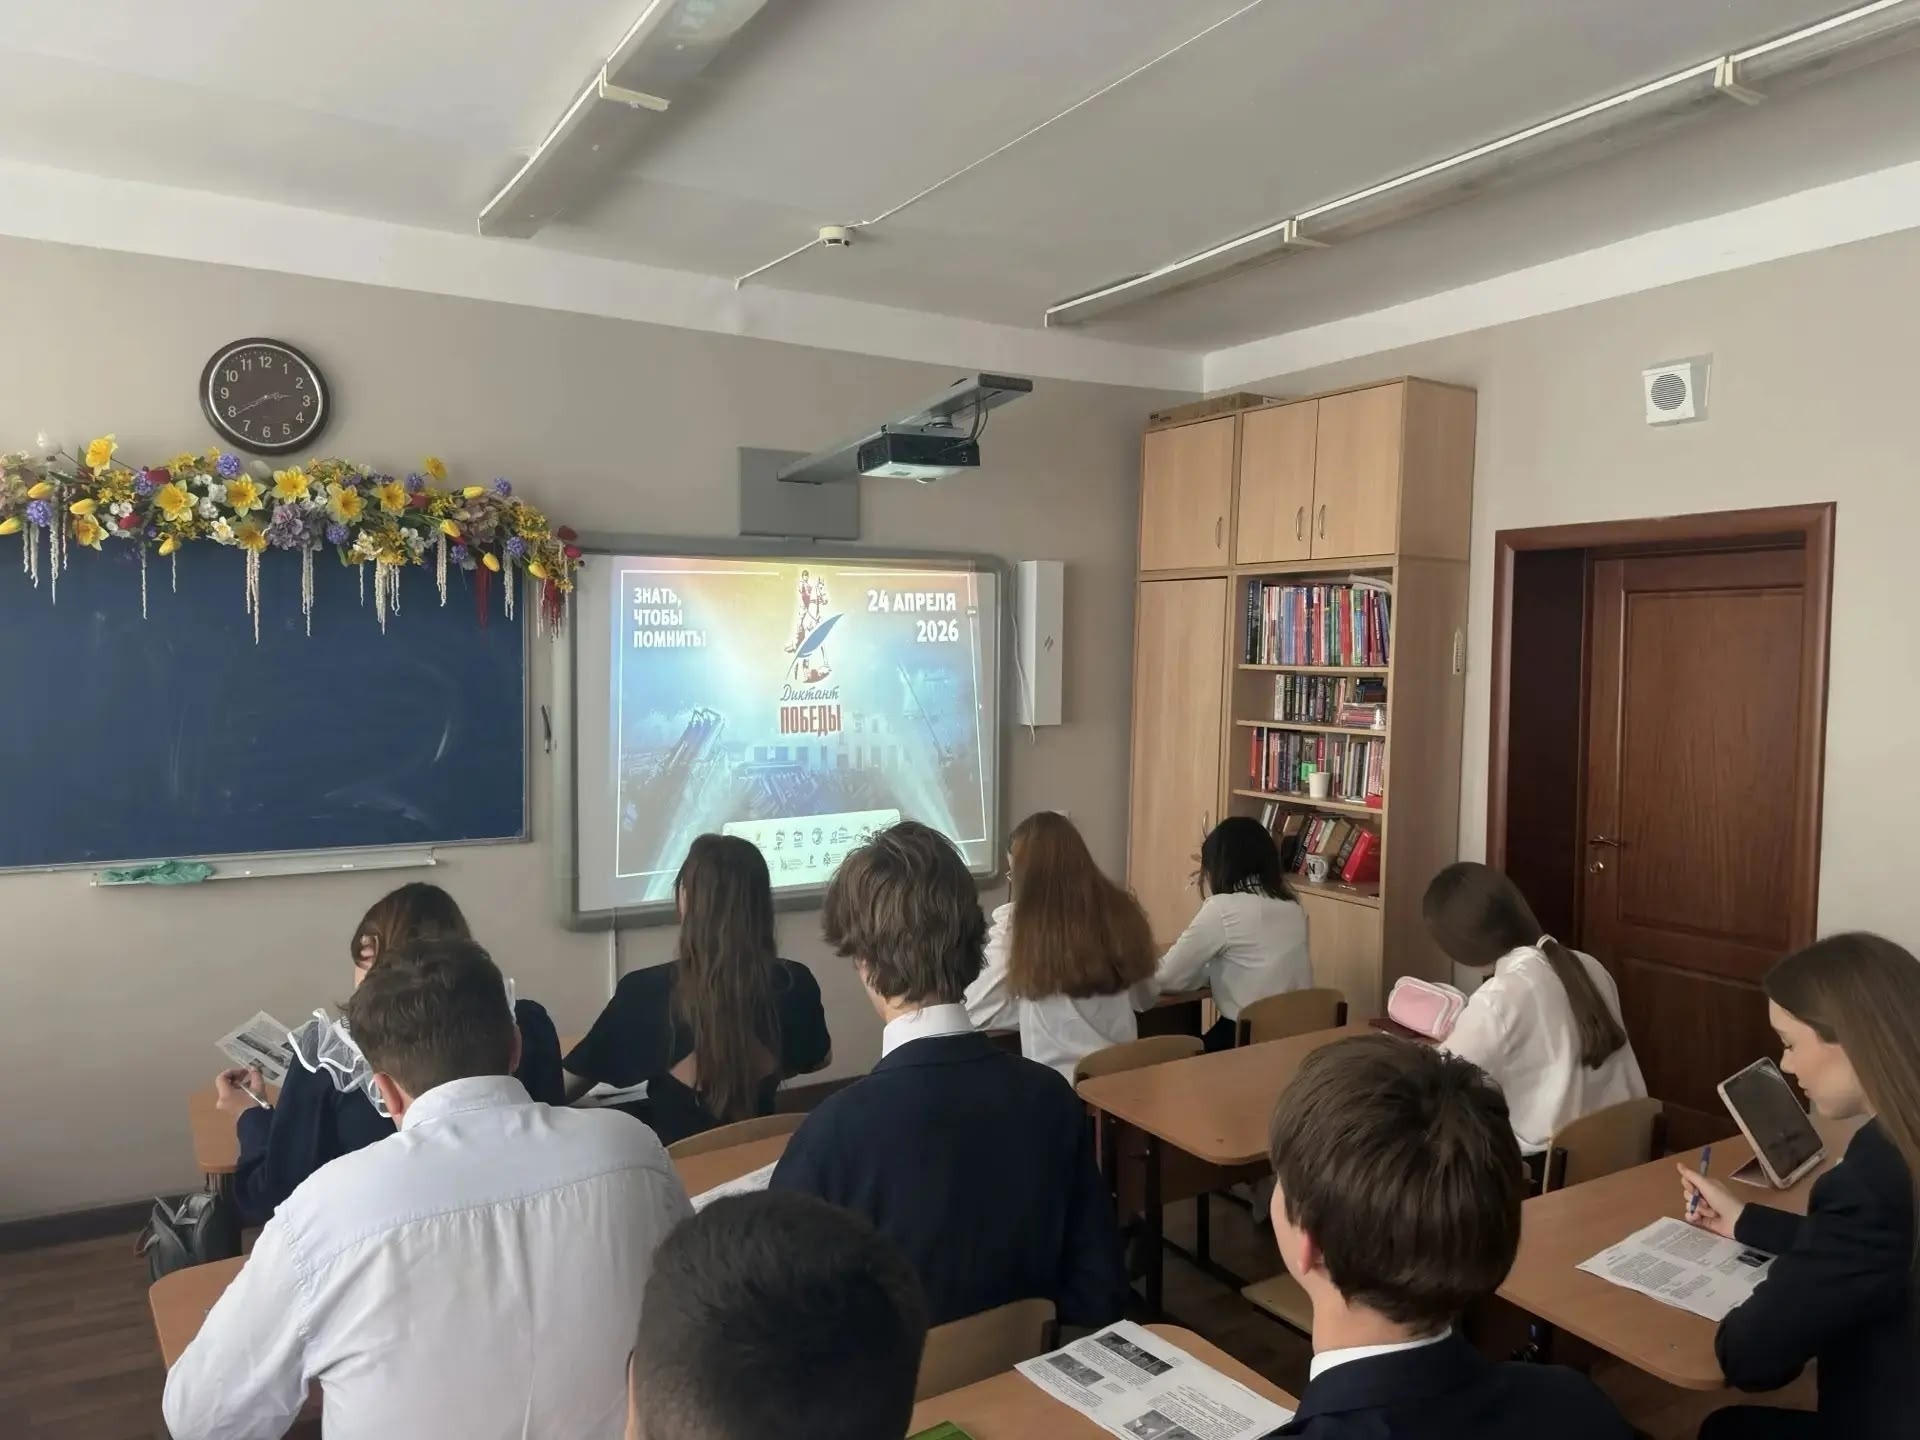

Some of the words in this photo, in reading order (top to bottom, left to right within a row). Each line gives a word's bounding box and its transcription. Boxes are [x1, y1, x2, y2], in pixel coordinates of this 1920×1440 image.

[241, 359, 252, 371] 11
[259, 356, 272, 368] 12
[225, 370, 238, 382] 10
[295, 377, 304, 389] 2
[220, 387, 229, 399] 9
[302, 395, 311, 407] 3
[228, 406, 237, 417] 8
[295, 412, 304, 423] 4
[243, 420, 251, 431] 7
[282, 424, 291, 435] 5
[262, 426, 271, 438] 6
[633, 587, 682, 606] ЗНАТЬ,
[867, 590, 889, 612] 24
[893, 591, 957, 612] АПРЕЛЯ
[633, 609, 682, 626] ЧТОБЫ
[916, 619, 959, 643] 2026
[633, 630, 706, 648] ПОМНИТЬ!
[780, 684, 840, 702] Диктант
[780, 704, 842, 736] ПОБЕДЫ
